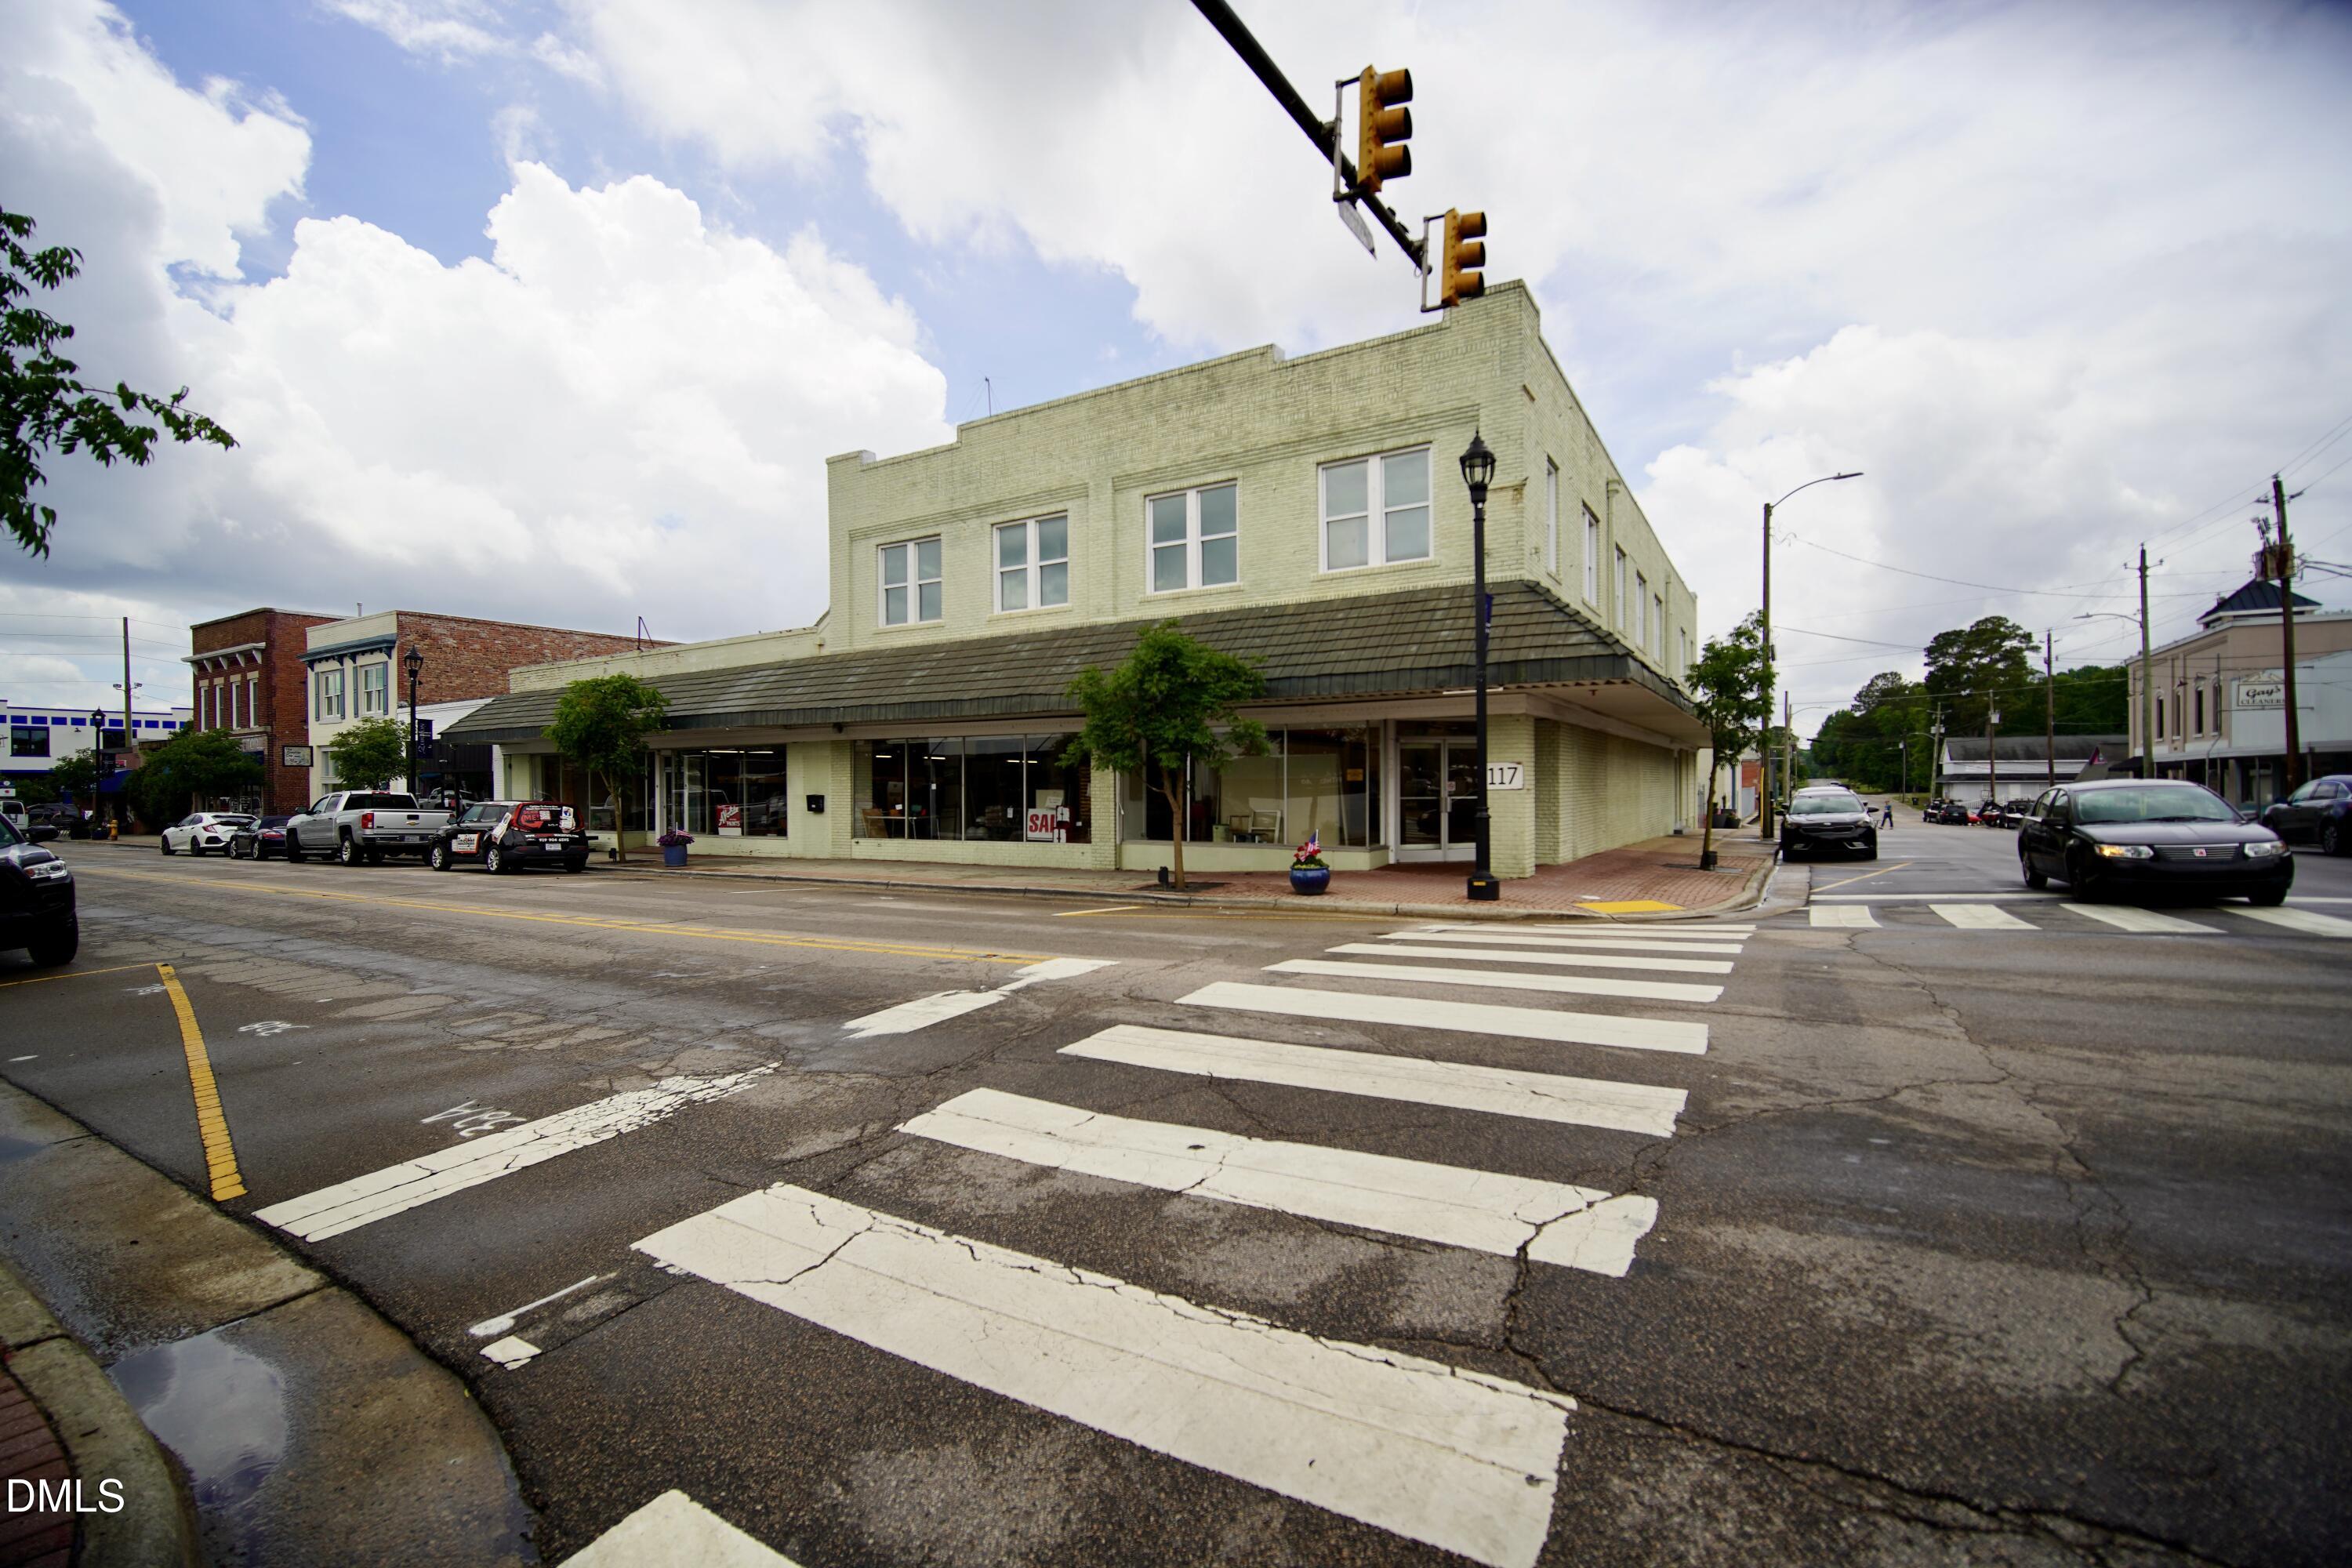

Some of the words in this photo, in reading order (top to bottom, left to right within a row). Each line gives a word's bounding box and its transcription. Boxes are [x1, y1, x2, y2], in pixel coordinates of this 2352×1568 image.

[2246, 685, 2281, 699] Gay's
[1488, 767, 1517, 785] 117
[1029, 814, 1054, 833] SAL
